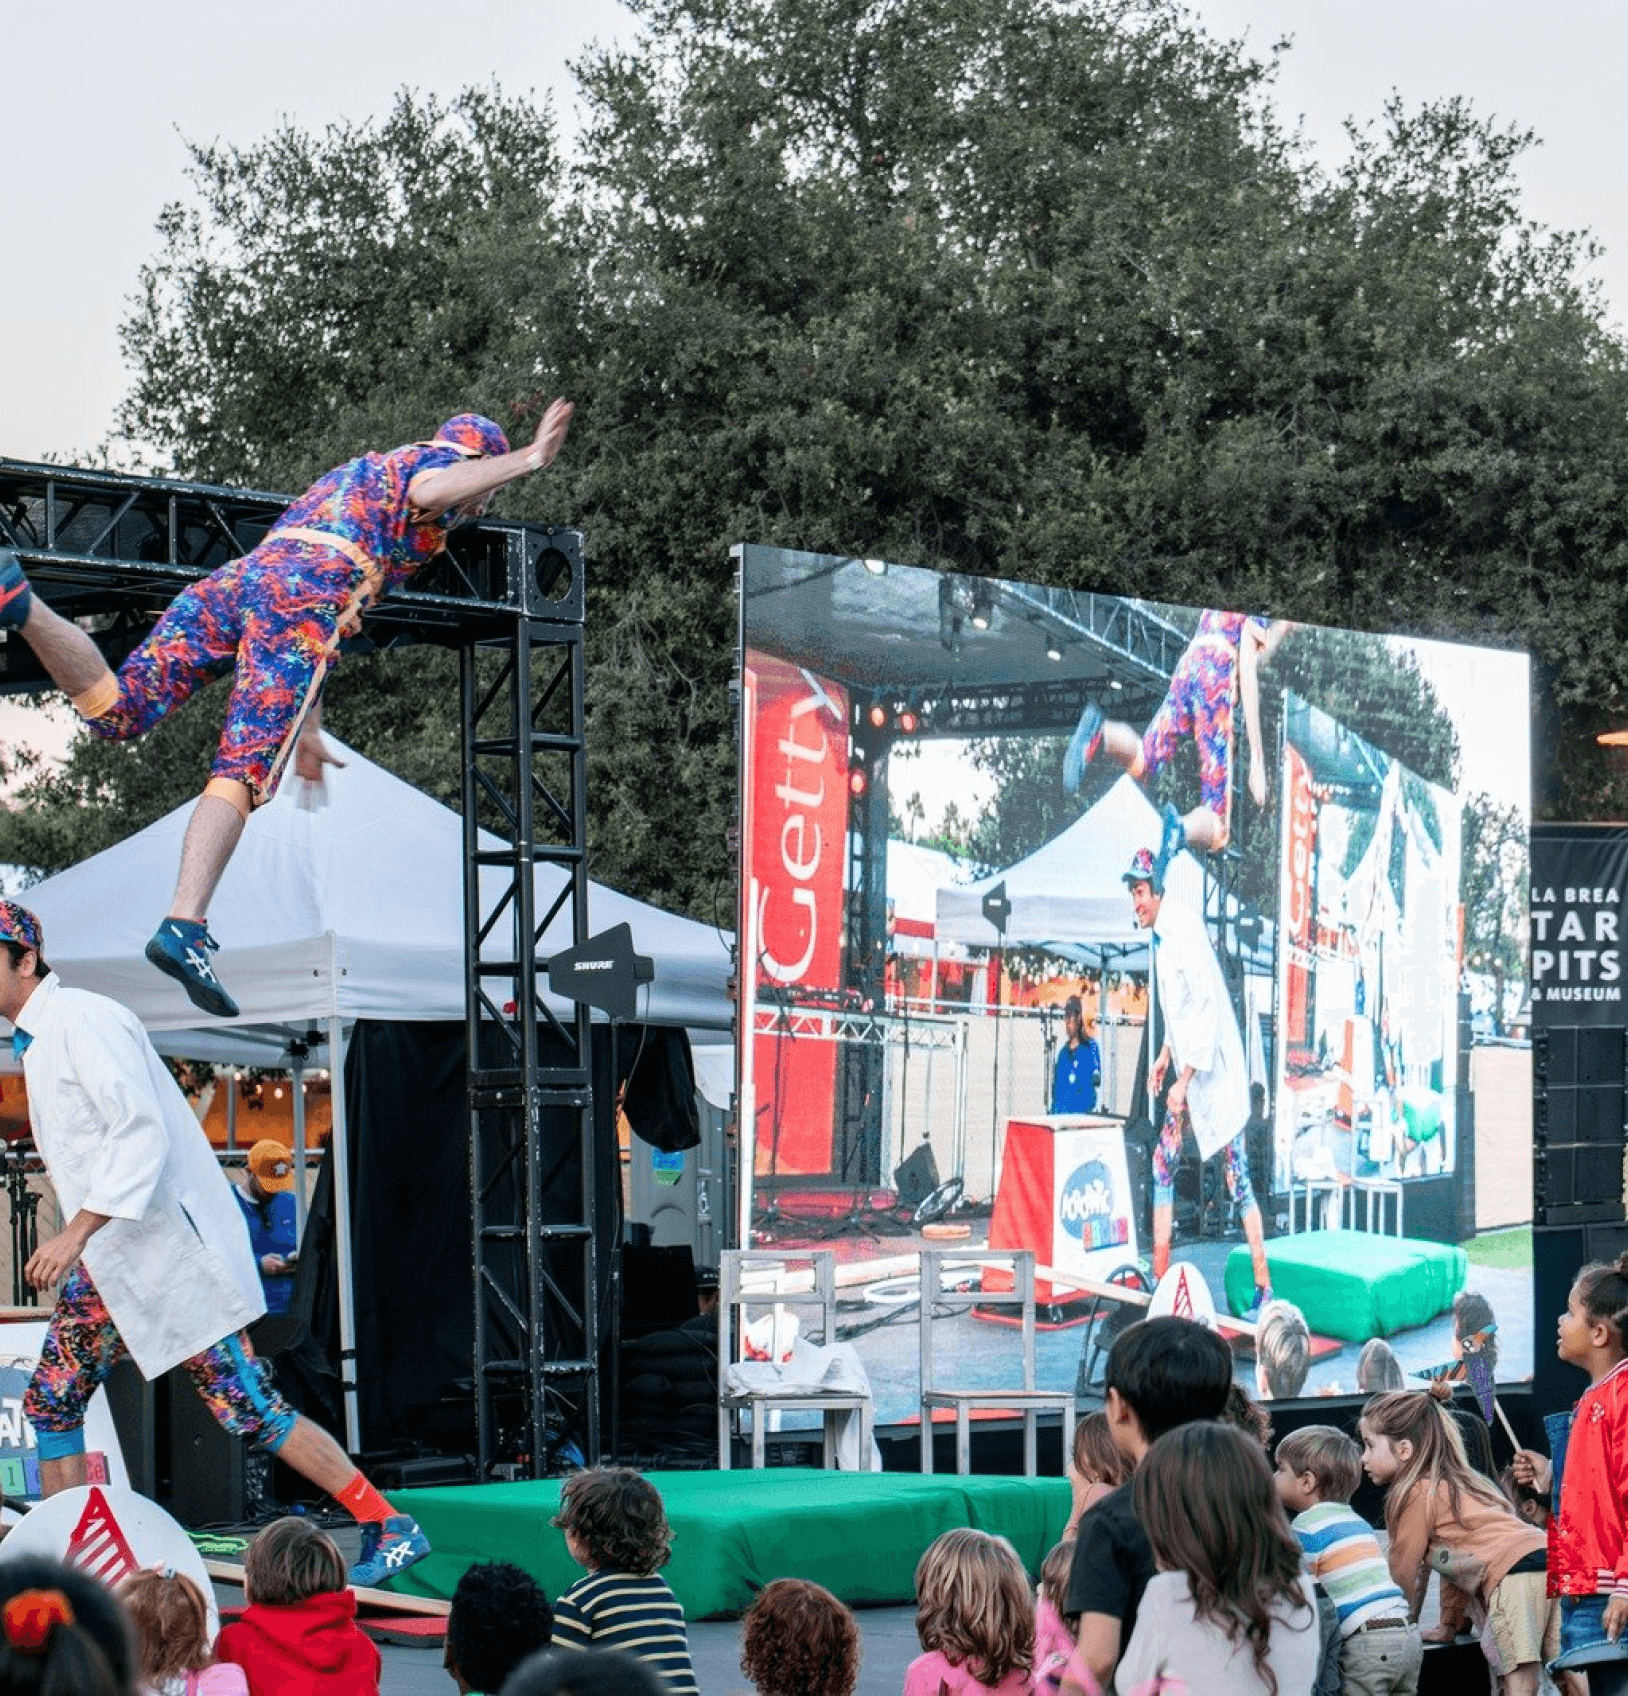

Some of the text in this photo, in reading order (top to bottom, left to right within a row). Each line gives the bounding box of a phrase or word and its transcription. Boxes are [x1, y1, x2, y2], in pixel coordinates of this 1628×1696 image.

[758, 668, 842, 982] Getty
[1531, 887, 1620, 903] LA BREA
[1530, 910, 1620, 941] TAR
[573, 960, 615, 972] SHURE
[1532, 950, 1621, 981] PITS
[1546, 987, 1621, 1001] MUSEUM
